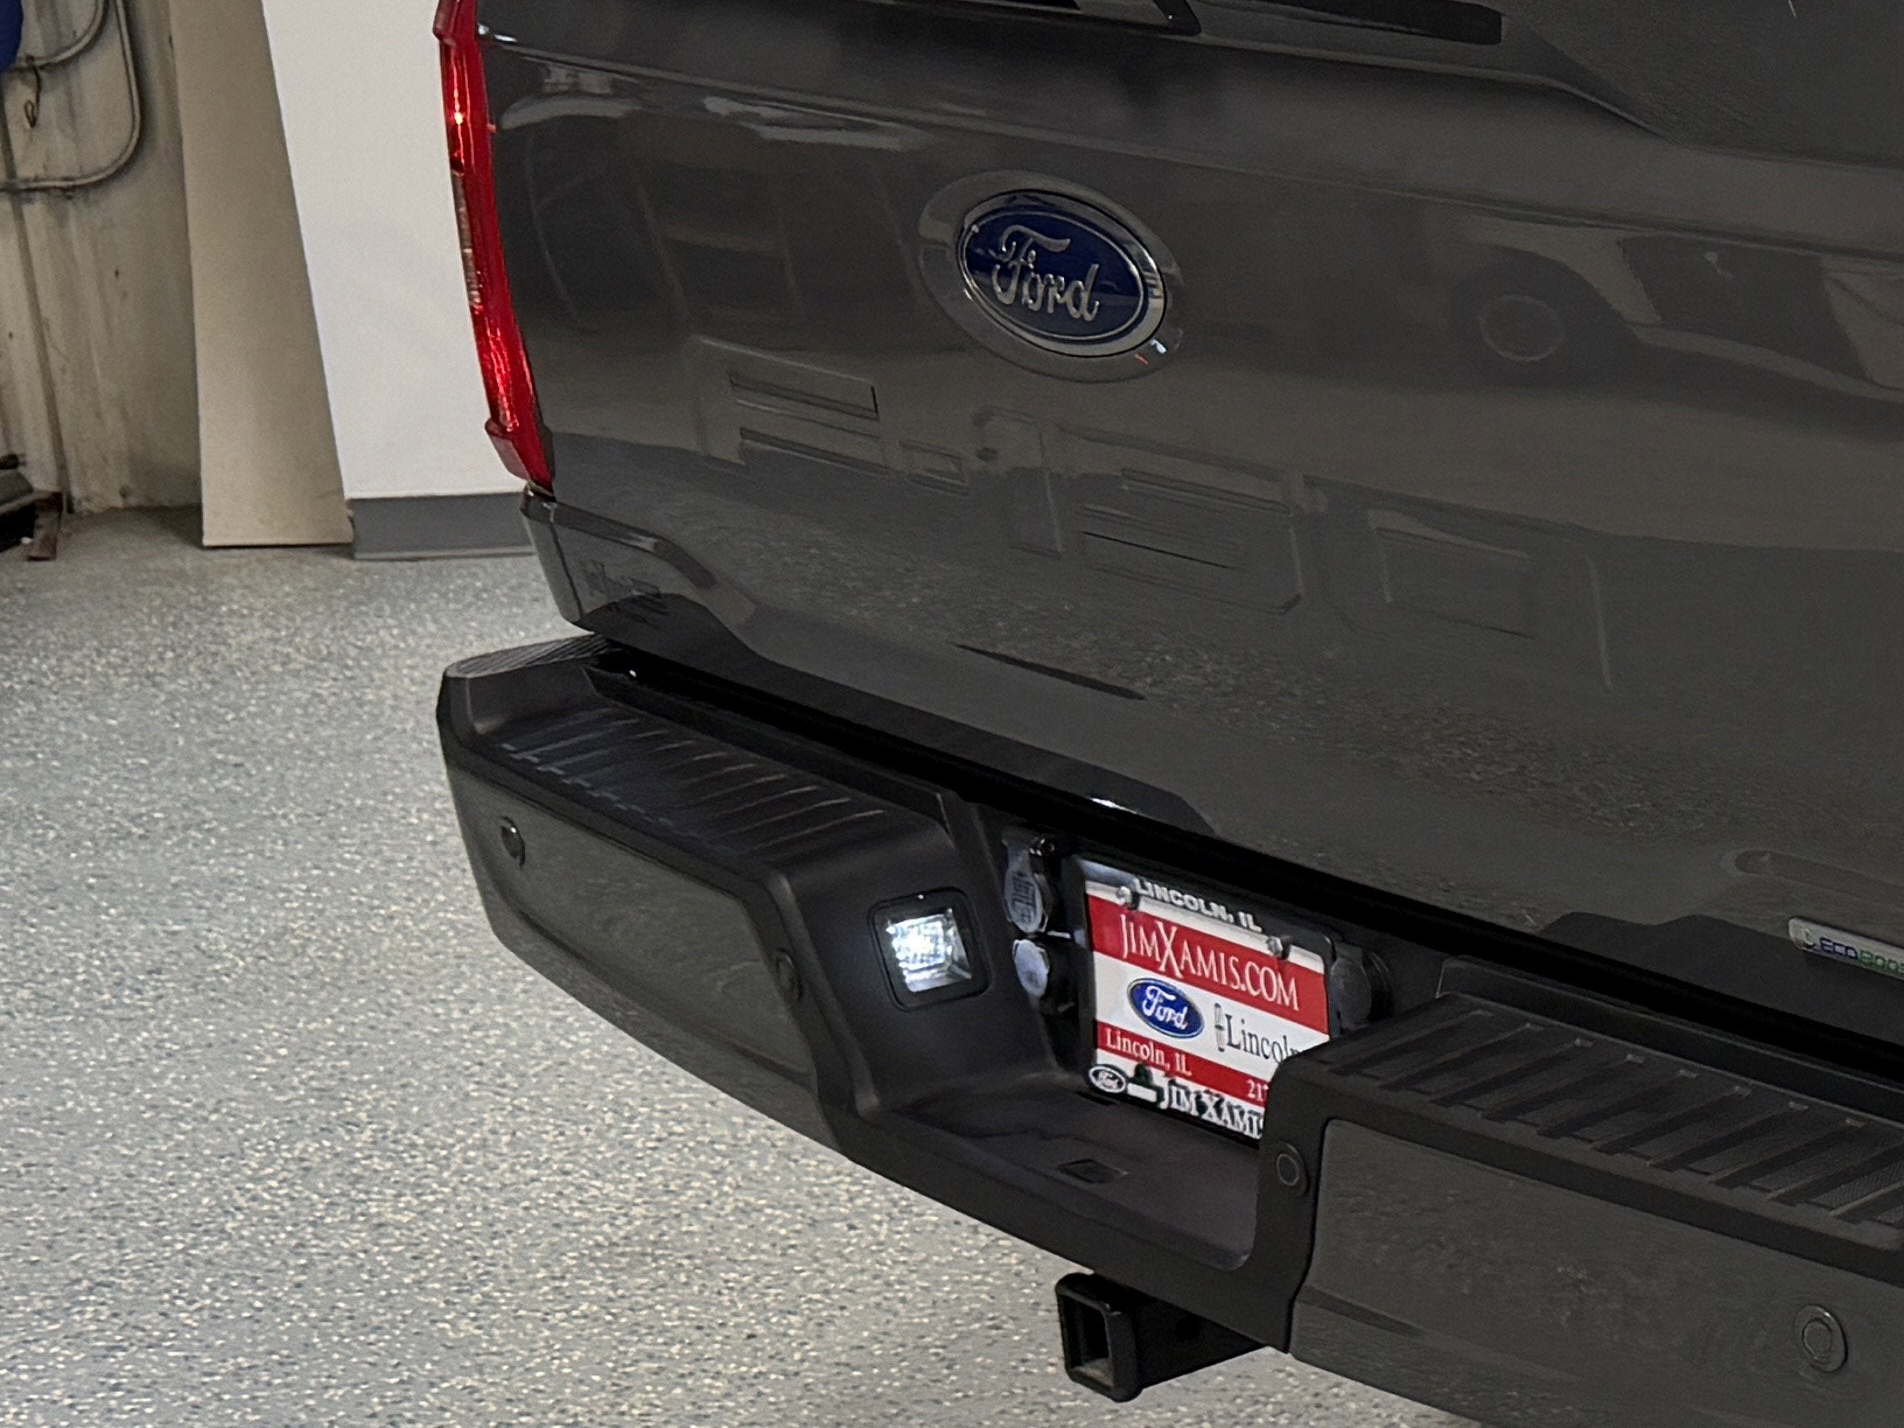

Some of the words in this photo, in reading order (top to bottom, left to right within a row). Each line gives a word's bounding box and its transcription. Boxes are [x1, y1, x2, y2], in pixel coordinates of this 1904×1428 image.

[990, 223, 1101, 322] Ford
[1134, 878, 1234, 924] LINCOLN,
[1240, 910, 1263, 933] IL
[1120, 913, 1299, 1011] JIMXAMIS.COM
[1141, 985, 1188, 1031] Ford
[1105, 1028, 1171, 1071] Lincoln,
[1175, 1052, 1193, 1076] IL
[1201, 1090, 1264, 1140] XAMI
